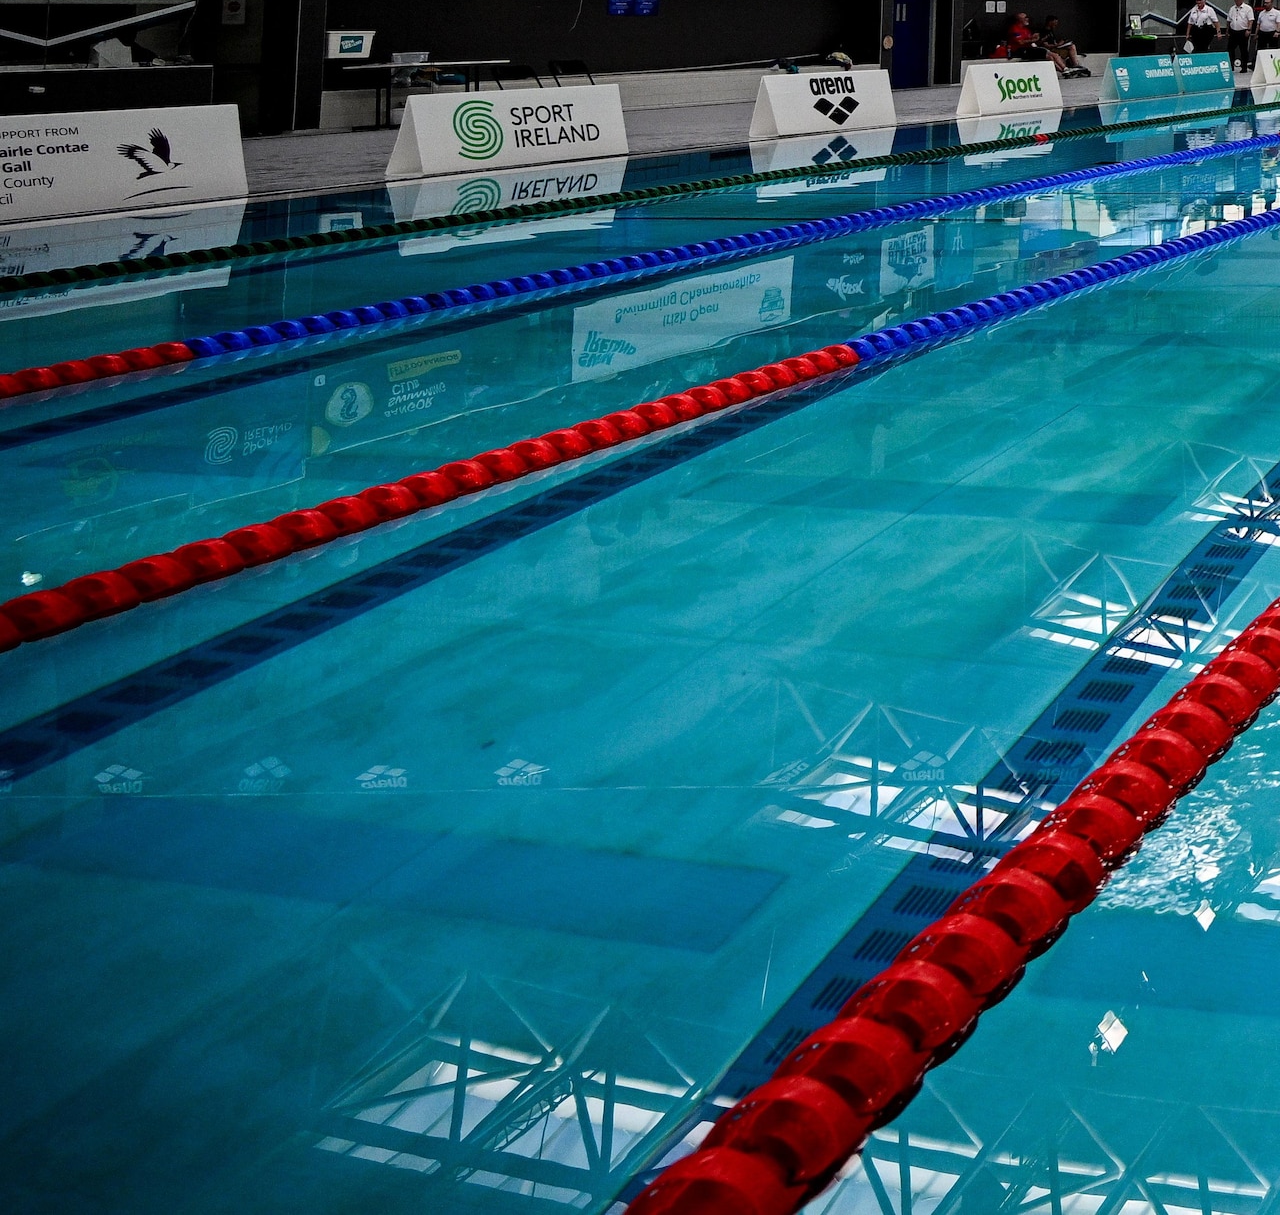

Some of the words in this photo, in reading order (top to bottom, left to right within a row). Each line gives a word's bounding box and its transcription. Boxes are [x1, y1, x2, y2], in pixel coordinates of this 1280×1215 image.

[1158, 58, 1171, 66] IRISH
[1179, 57, 1192, 65] OPEN
[1145, 68, 1174, 78] SWIMMING
[1180, 65, 1219, 76] CHAMPIONSHIPS
[809, 75, 855, 96] arena
[510, 103, 574, 126] SPORT
[0, 129, 41, 139] PPORT
[45, 127, 79, 136] FROM
[514, 123, 600, 149] IRELAND
[0, 146, 33, 157] airle
[36, 143, 89, 155] Contae
[3, 176, 54, 188] County
